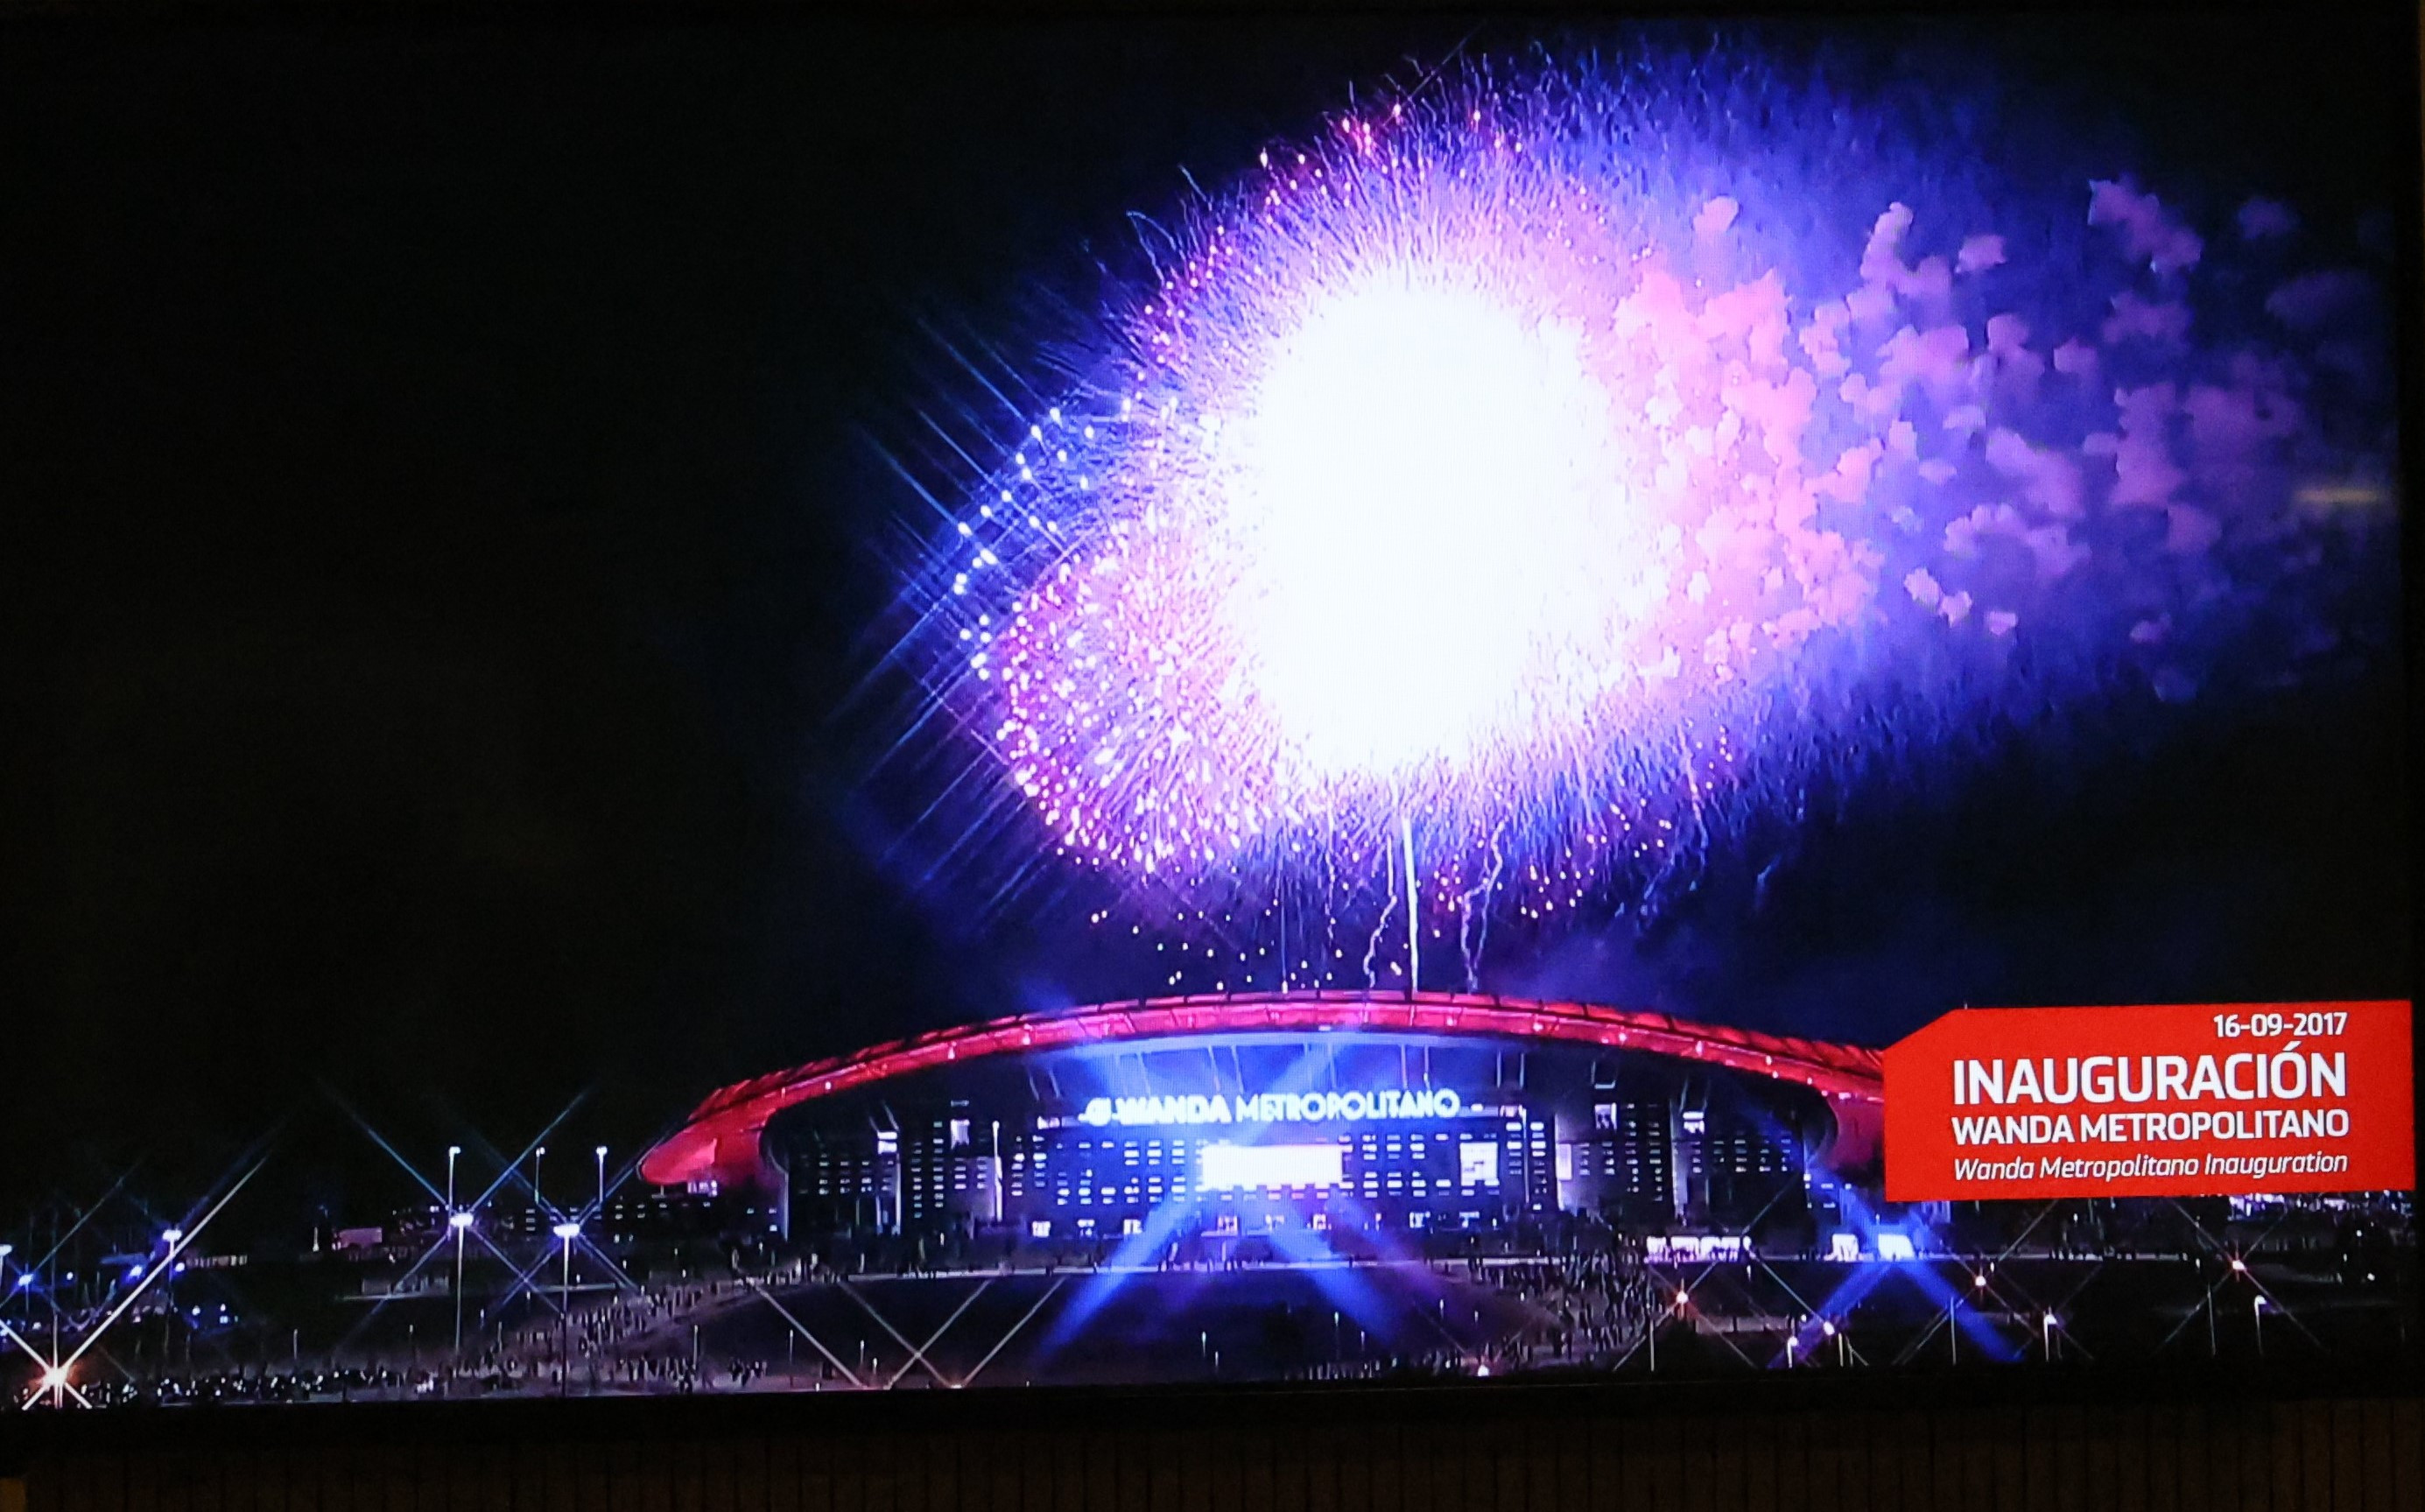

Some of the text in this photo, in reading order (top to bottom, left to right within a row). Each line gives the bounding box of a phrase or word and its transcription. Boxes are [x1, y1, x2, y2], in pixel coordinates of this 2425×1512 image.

[2213, 1012, 2348, 1037] 16-09-2017
[1953, 1041, 2347, 1105] INAUGURACIÓN
[1115, 1089, 1460, 1125] WANDA METROPOLITANO
[1951, 1109, 2349, 1145] WANDA METROPOLITANO
[1954, 1151, 2348, 1182] Wanda Metropolitano Inauguration
